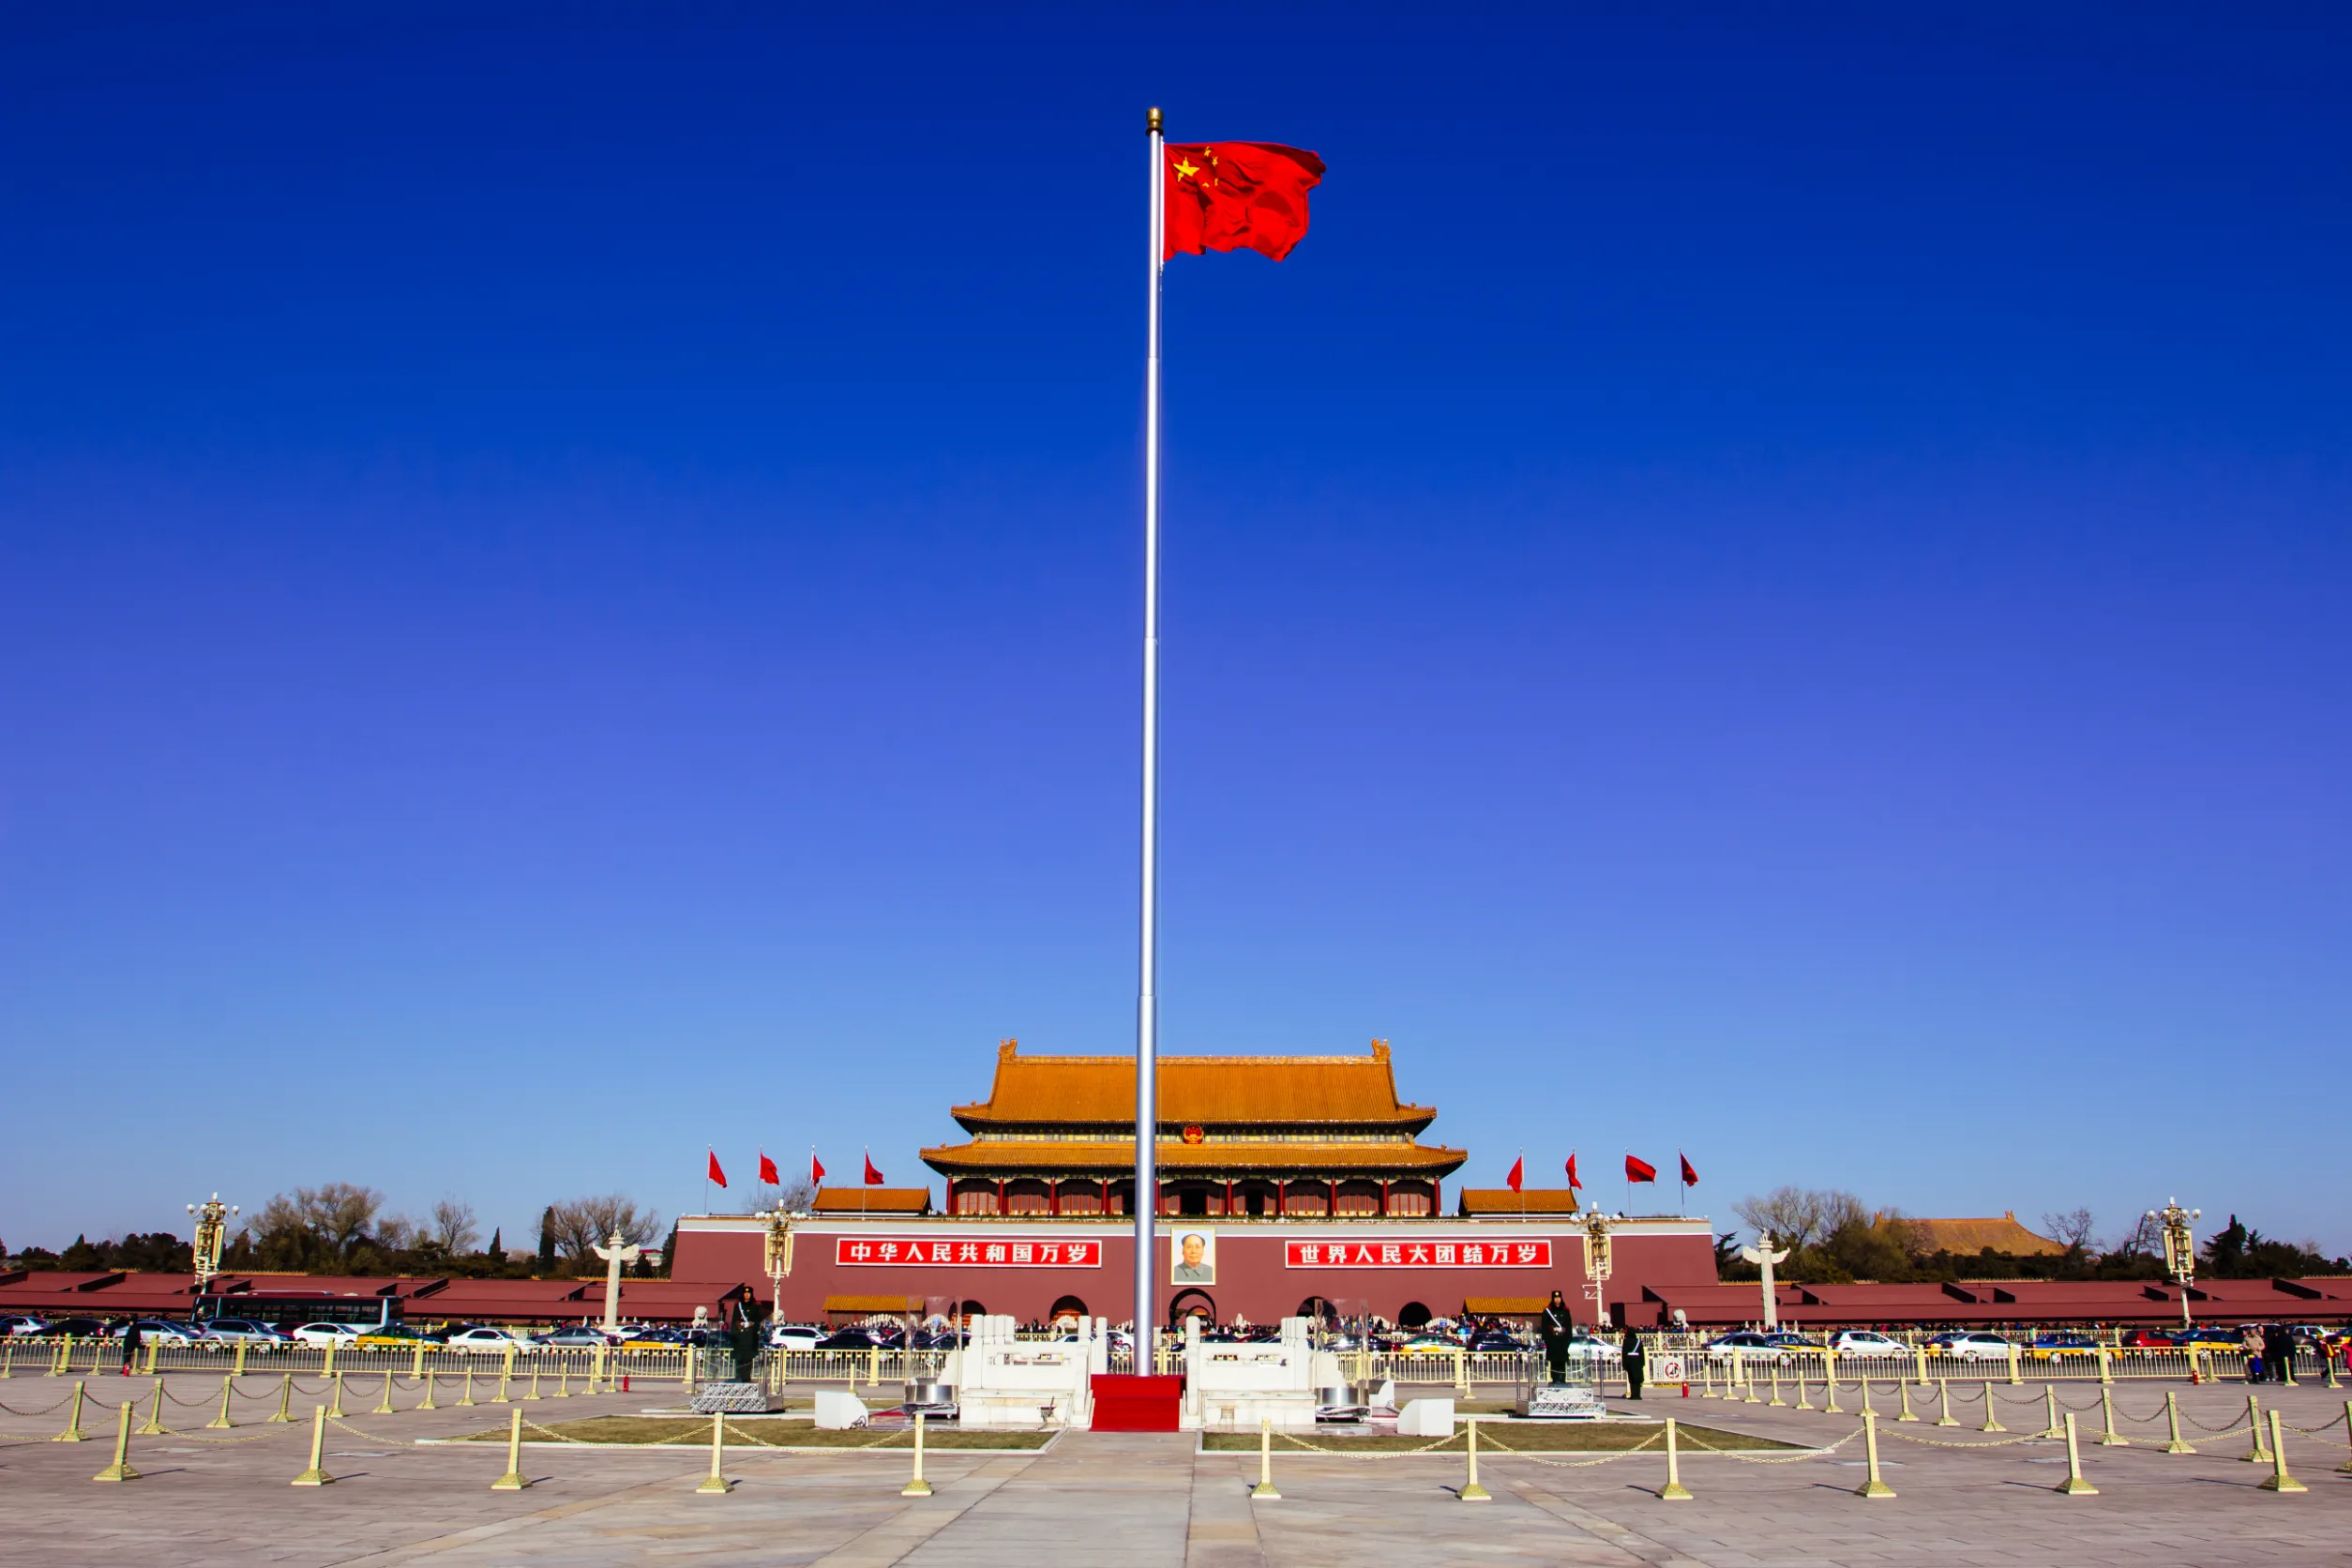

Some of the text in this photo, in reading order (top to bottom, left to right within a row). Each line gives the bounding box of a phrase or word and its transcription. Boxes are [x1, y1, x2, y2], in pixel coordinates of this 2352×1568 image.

[851, 1243, 1089, 1263] 中华人民共和国万岁
[1300, 1244, 1537, 1264] 世界人民大团结万岁
